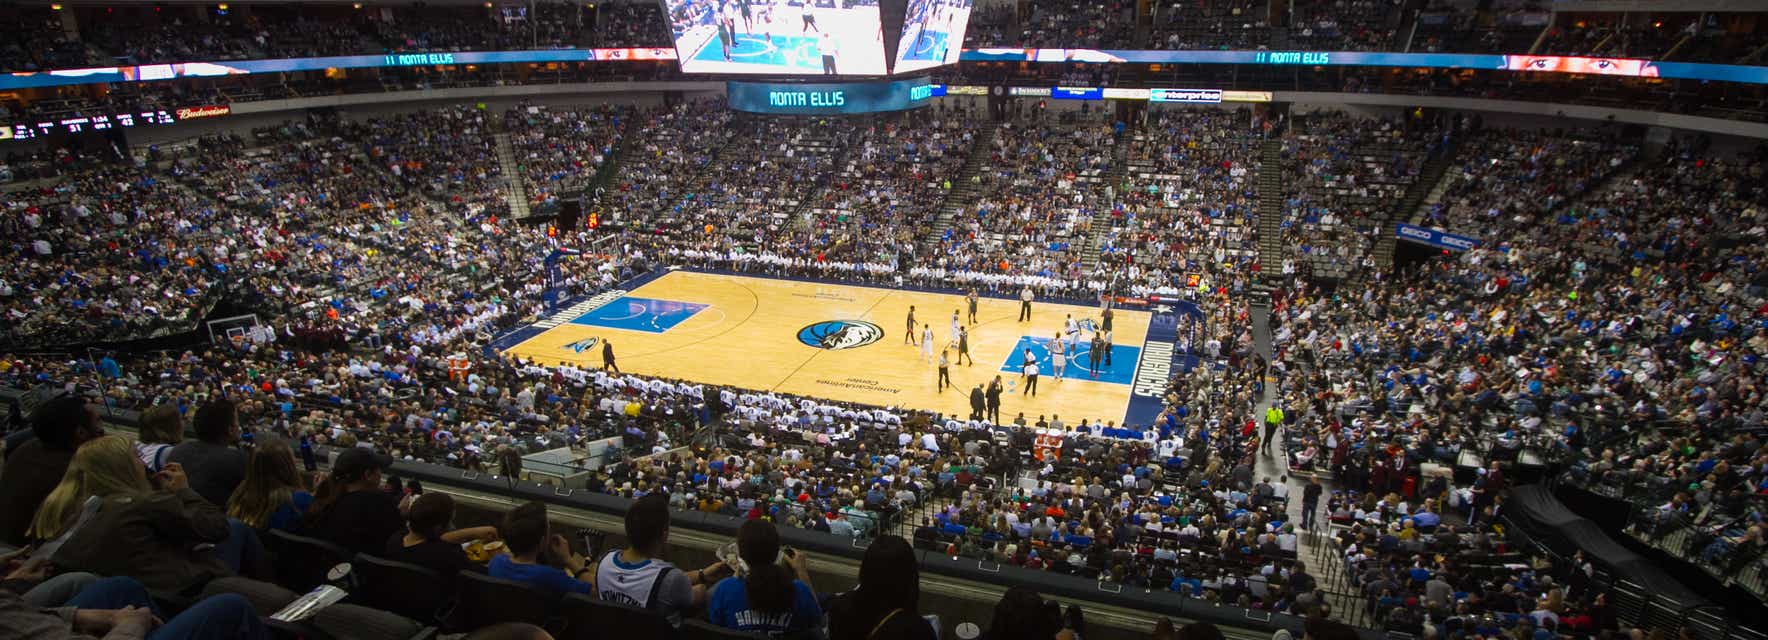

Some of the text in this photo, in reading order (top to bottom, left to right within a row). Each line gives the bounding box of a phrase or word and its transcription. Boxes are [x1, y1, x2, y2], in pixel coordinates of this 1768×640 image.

[385, 53, 454, 65] 11 MONTA ELLIS
[1256, 52, 1329, 64] 11 MONTA ELLIS
[769, 91, 845, 106] MONTA ELLIS
[177, 105, 230, 120] Budweiser
[69, 124, 82, 132] 51
[1134, 340, 1175, 398] MAVERICKS
